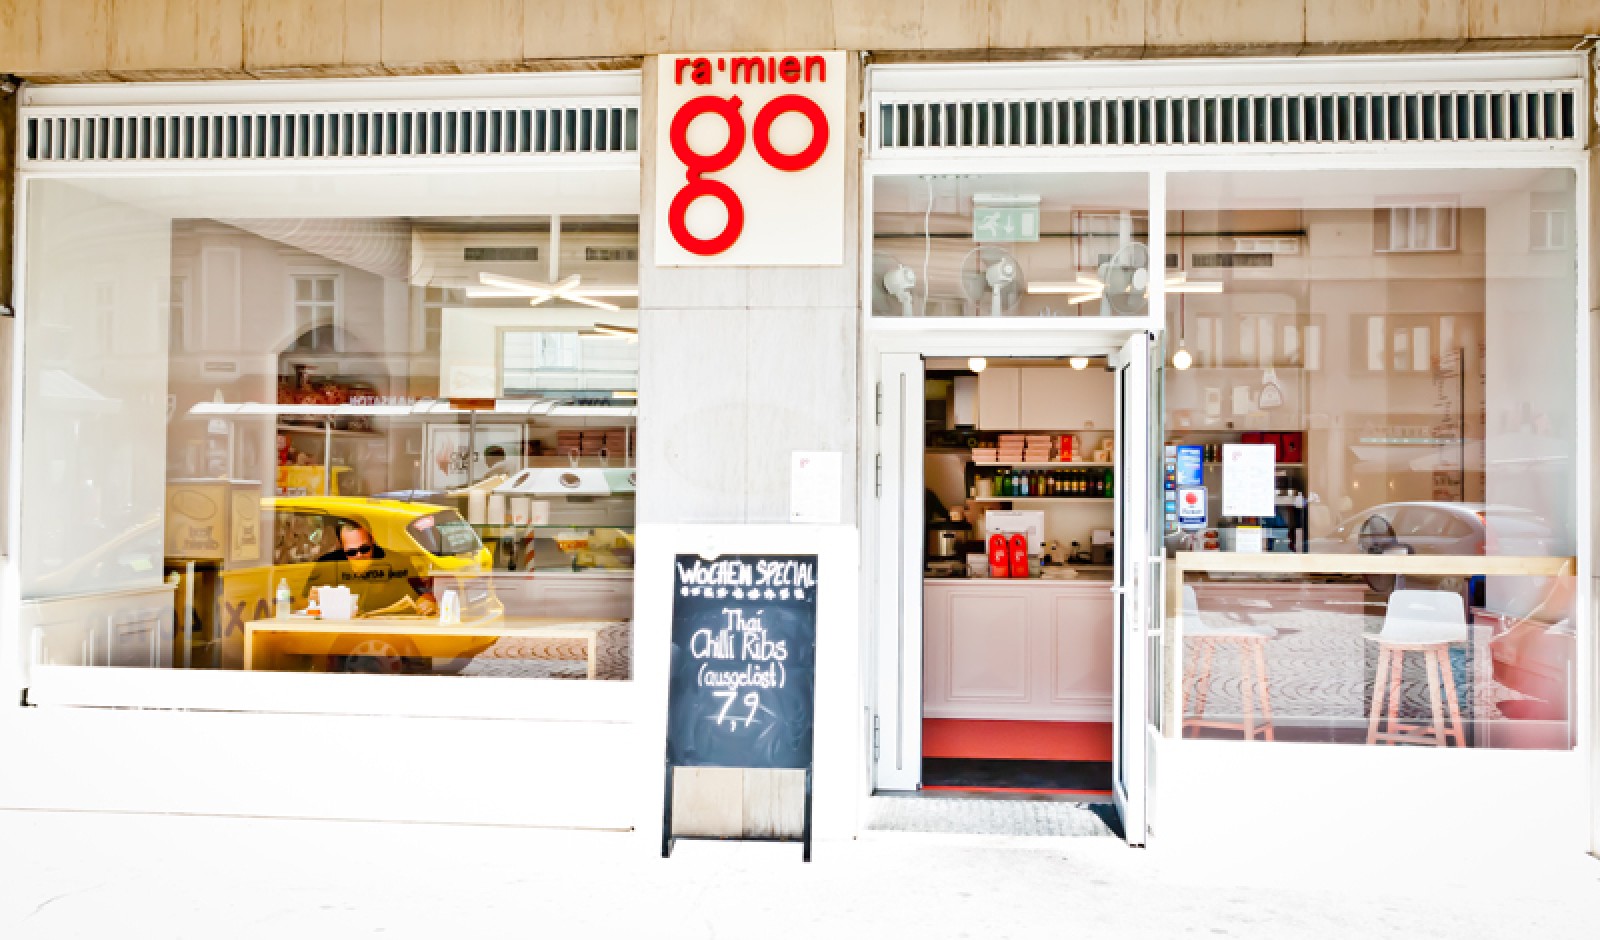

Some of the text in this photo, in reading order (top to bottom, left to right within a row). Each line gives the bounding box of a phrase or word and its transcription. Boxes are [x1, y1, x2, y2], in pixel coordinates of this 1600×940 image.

[674, 55, 826, 86] ra'mien
[668, 94, 830, 257] go
[676, 558, 817, 588] WOCHEN SPECIAL
[722, 607, 764, 632] Thai
[741, 629, 789, 661] Ribs
[711, 690, 761, 733] 7,9
